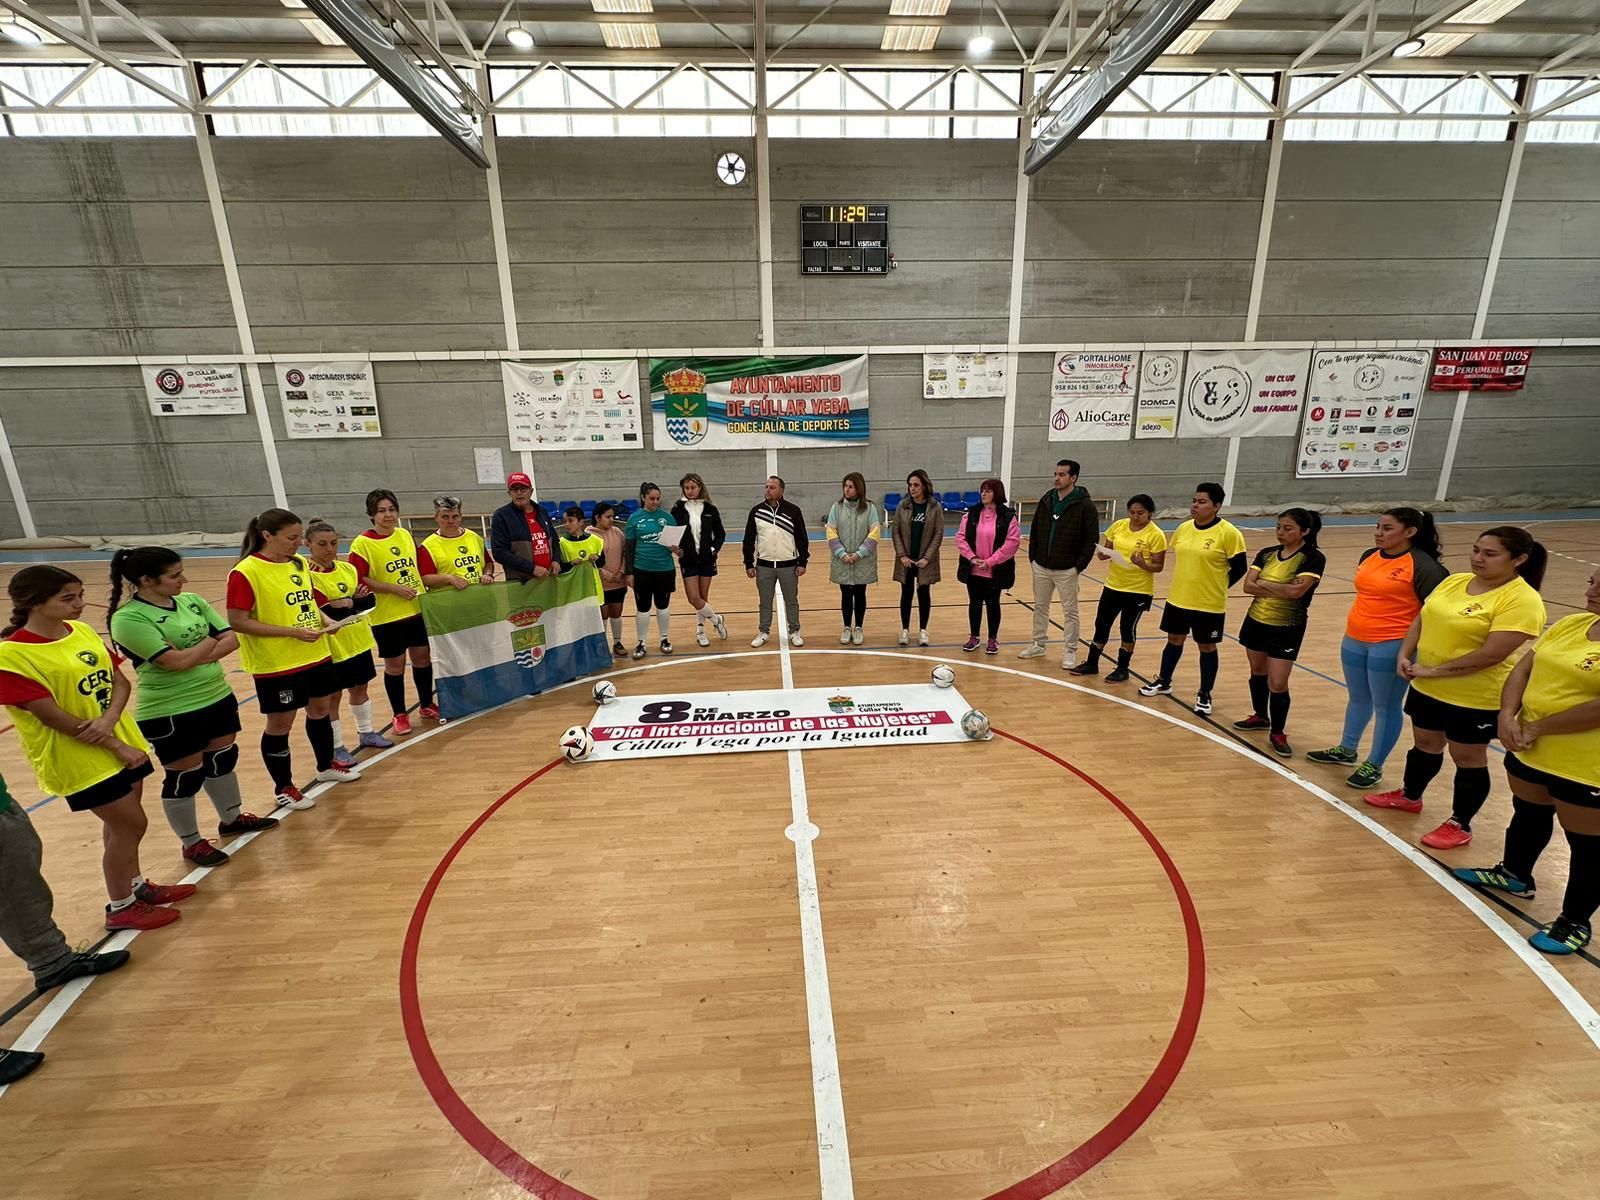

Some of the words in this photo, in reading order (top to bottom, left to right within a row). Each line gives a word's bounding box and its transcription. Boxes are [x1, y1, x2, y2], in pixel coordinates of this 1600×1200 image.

[830, 206, 866, 222] 11:29
[1078, 354, 1132, 362] PORTALHOME
[1318, 358, 1333, 369] Con
[1334, 355, 1342, 363] tu
[1366, 353, 1395, 362] seguimos
[1395, 355, 1424, 366] creciendo
[1438, 350, 1460, 361] SAN
[1459, 351, 1487, 363] JUAN
[1488, 351, 1503, 361] DE
[1503, 351, 1529, 361] DIOS
[1198, 368, 1212, 381] Club
[1456, 366, 1504, 374] PERFUMERIA
[730, 374, 841, 394] AYUNTAMIENTO
[1265, 375, 1276, 383] UN
[1259, 390, 1270, 398] UN
[1270, 390, 1297, 398] EQUIPO
[726, 400, 745, 417] DE
[749, 394, 807, 417] CÚLLAR
[811, 397, 850, 415] VEGA
[1252, 405, 1267, 413] UNA
[1268, 404, 1298, 413] FAMILIA
[1075, 410, 1131, 422] AlioCare
[1192, 405, 1205, 420] VEGA
[1213, 405, 1242, 422] GRANADA
[727, 417, 786, 433] CONCEJALÍA
[788, 420, 799, 432] DE
[802, 419, 850, 431] DEPORTES
[1141, 423, 1162, 431] adexo
[386, 556, 416, 573] GERA
[454, 554, 480, 568] GERA
[638, 701, 692, 724] 8
[692, 709, 791, 722] MARZO
[649, 719, 785, 738] Internacional
[790, 717, 815, 731] de
[820, 717, 849, 729] las
[612, 740, 688, 752] Cúllar
[694, 737, 748, 749] Vega
[755, 735, 796, 747] por
[802, 732, 822, 742] la
[831, 726, 929, 743] Igualdad
